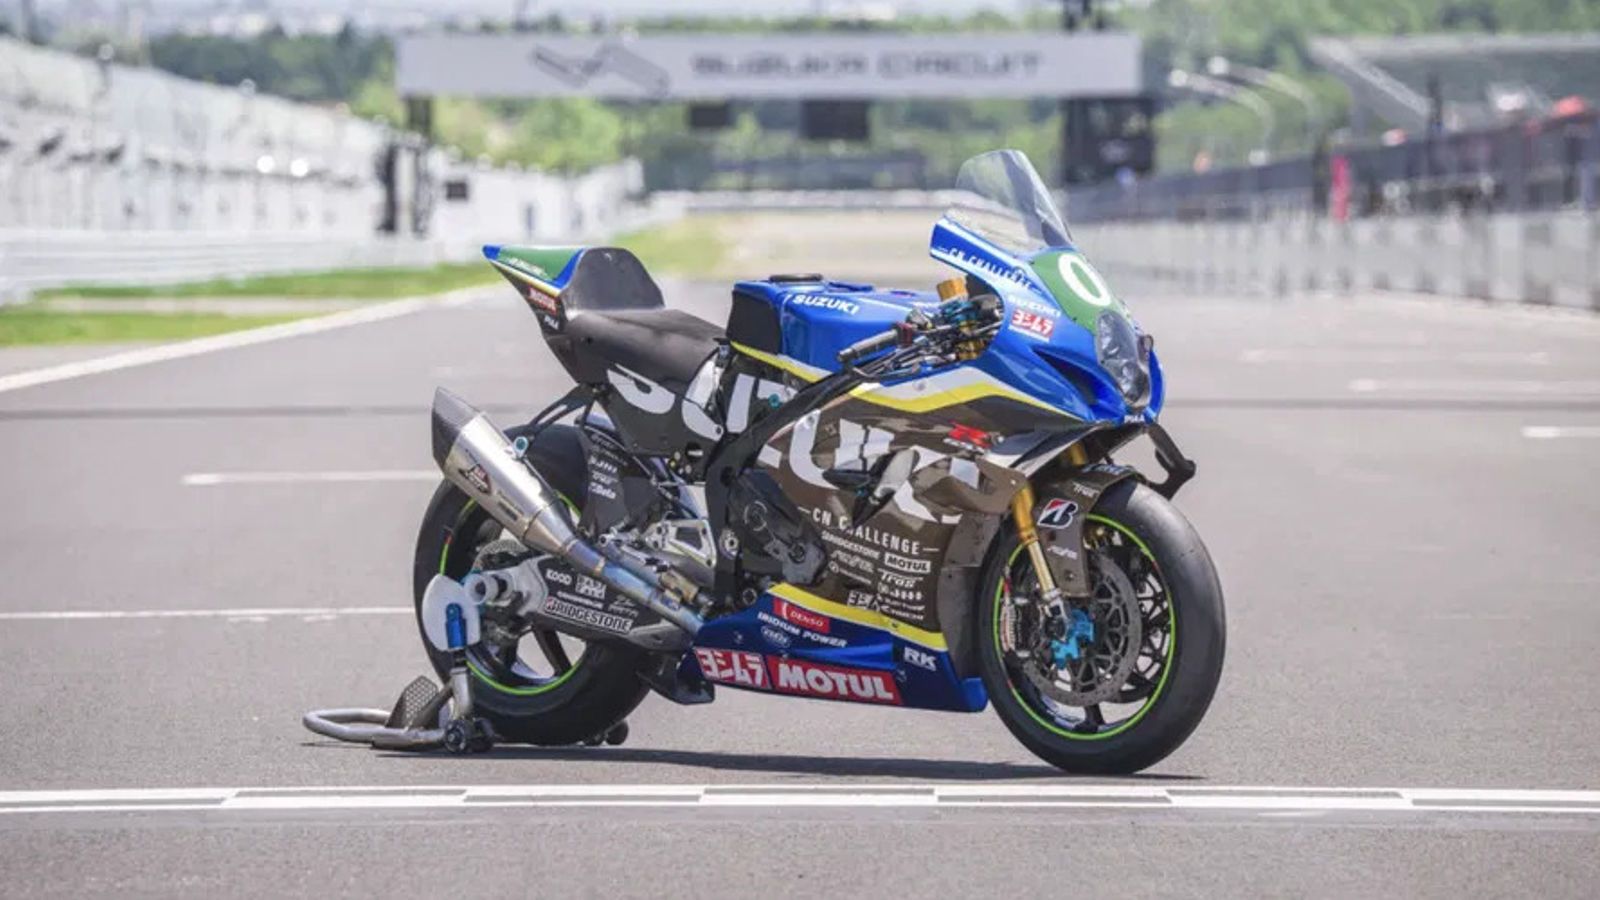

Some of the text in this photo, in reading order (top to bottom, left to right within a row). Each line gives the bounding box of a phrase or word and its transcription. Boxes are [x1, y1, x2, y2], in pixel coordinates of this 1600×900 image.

[1058, 253, 1111, 307] 0
[792, 294, 860, 315] SUZUKI
[812, 507, 832, 526] CN
[546, 568, 572, 586] KOOD
[886, 556, 928, 571] MOTUL
[546, 596, 633, 633] BRIDGESTONE
[757, 611, 801, 636] IRIDIUM
[802, 630, 848, 648] POWER
[699, 650, 765, 687] ヨシムラ
[903, 646, 937, 672] RK
[778, 663, 895, 699] MOTUL
